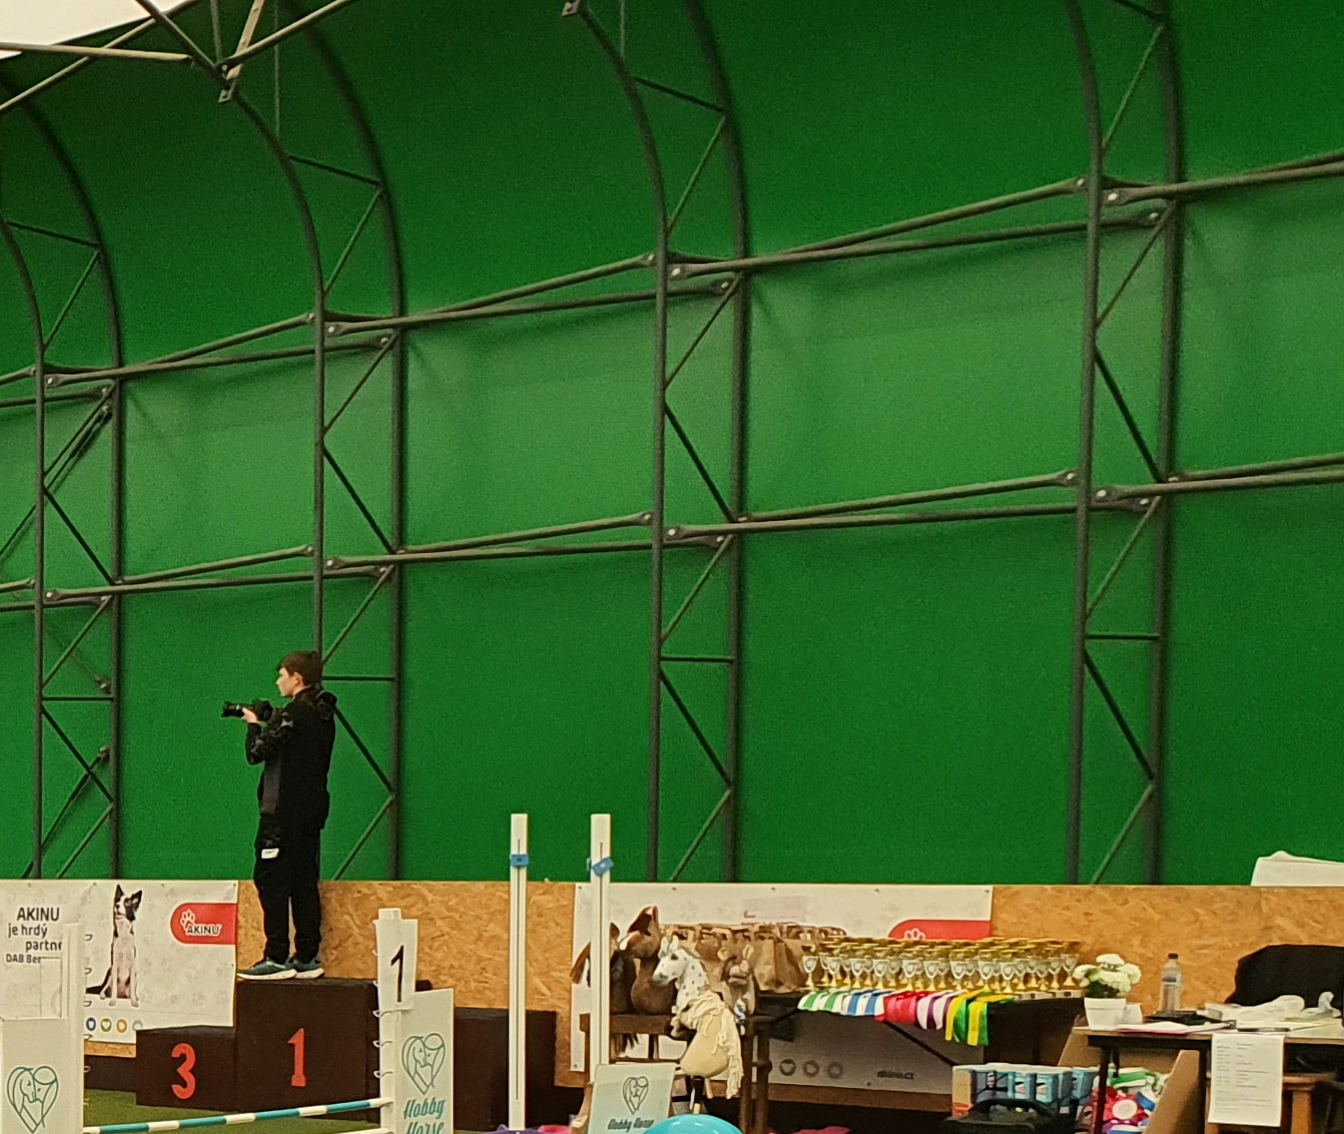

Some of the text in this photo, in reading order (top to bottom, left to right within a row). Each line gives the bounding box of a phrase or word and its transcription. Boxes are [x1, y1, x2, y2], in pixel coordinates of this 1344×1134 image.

[16, 906, 60, 922] AKINU
[7, 922, 48, 939] je hrdý
[186, 925, 221, 935] AKINU
[5, 953, 25, 963] DAB
[390, 944, 405, 1003] 1
[288, 1028, 307, 1087] 1
[171, 1042, 196, 1100] 3
[403, 1097, 445, 1119] Hobby
